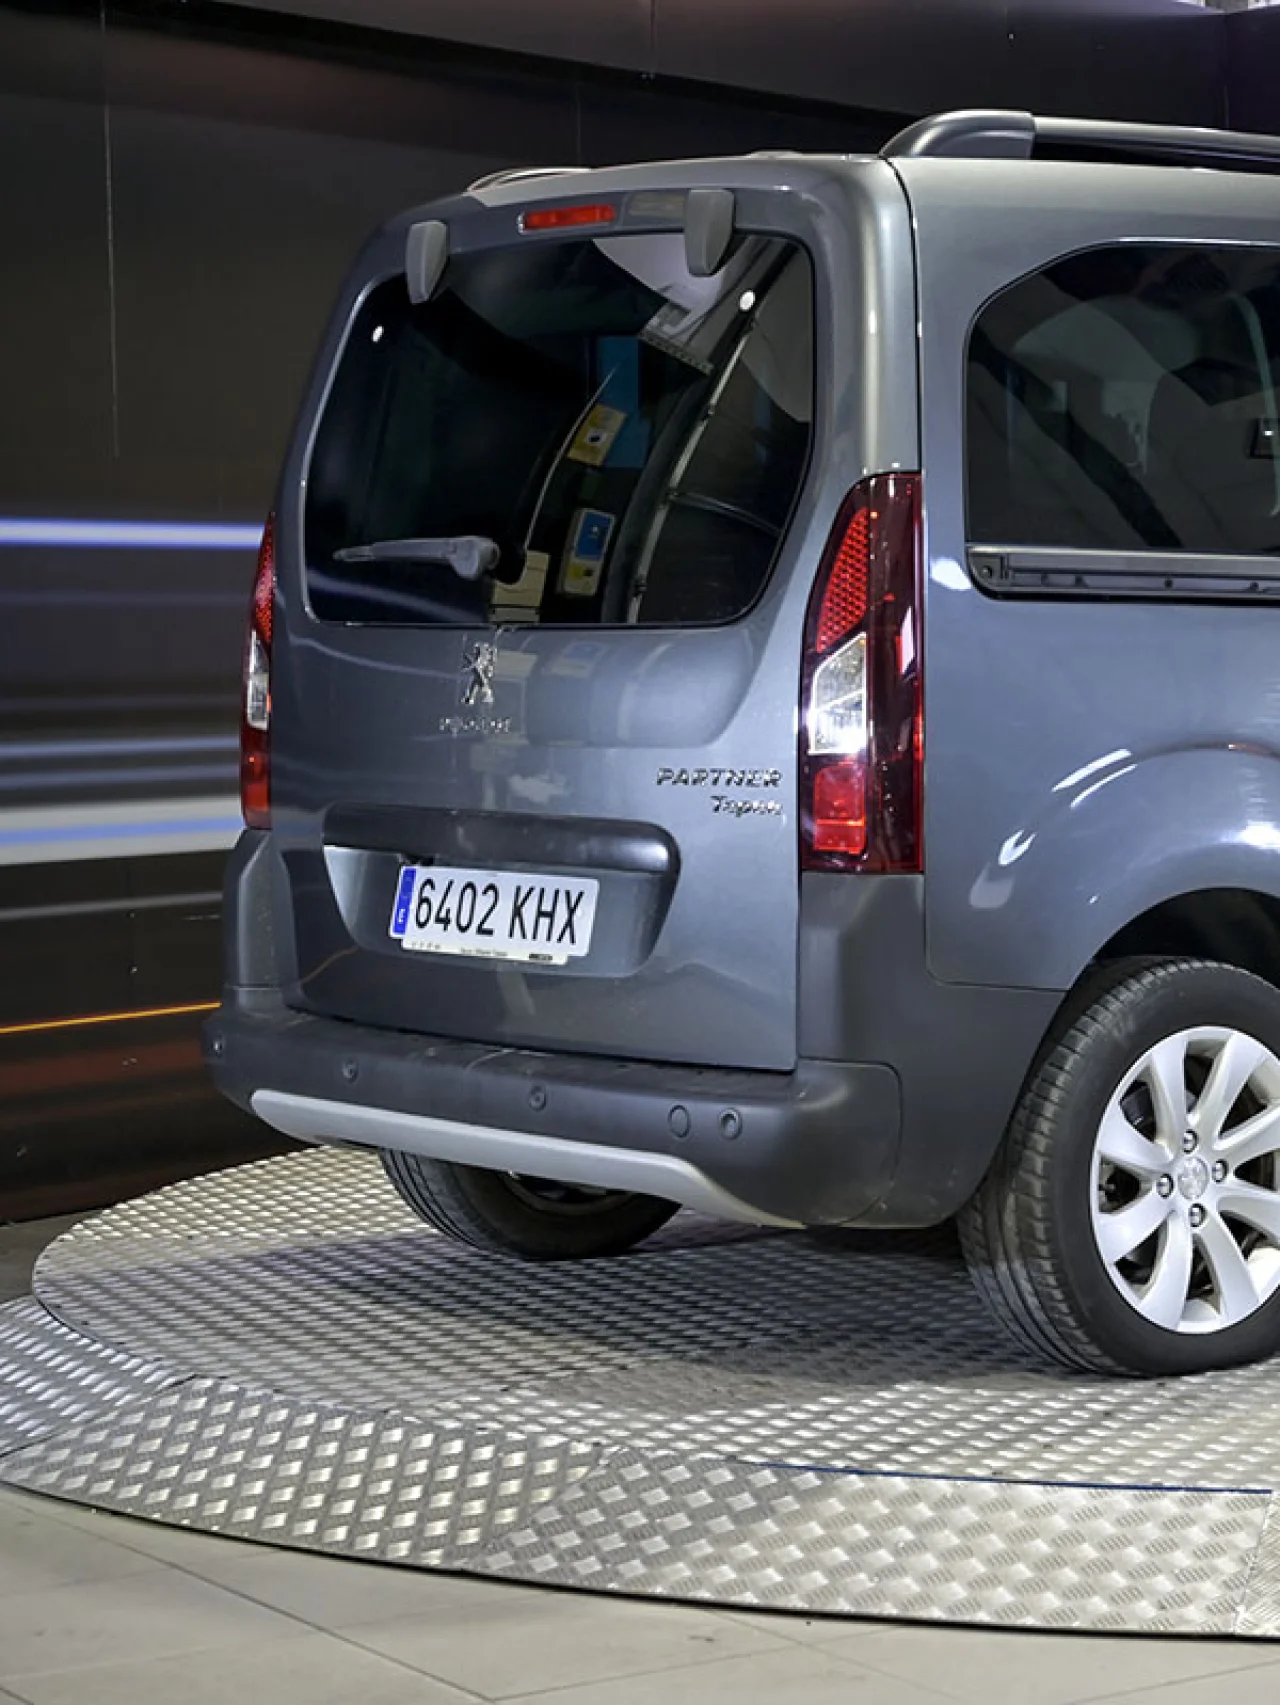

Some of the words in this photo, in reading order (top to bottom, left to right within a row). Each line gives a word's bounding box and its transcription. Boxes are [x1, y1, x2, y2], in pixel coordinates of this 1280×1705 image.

[656, 767, 783, 788] PARTNER
[415, 877, 500, 937] 6402
[508, 884, 586, 945] KHX
